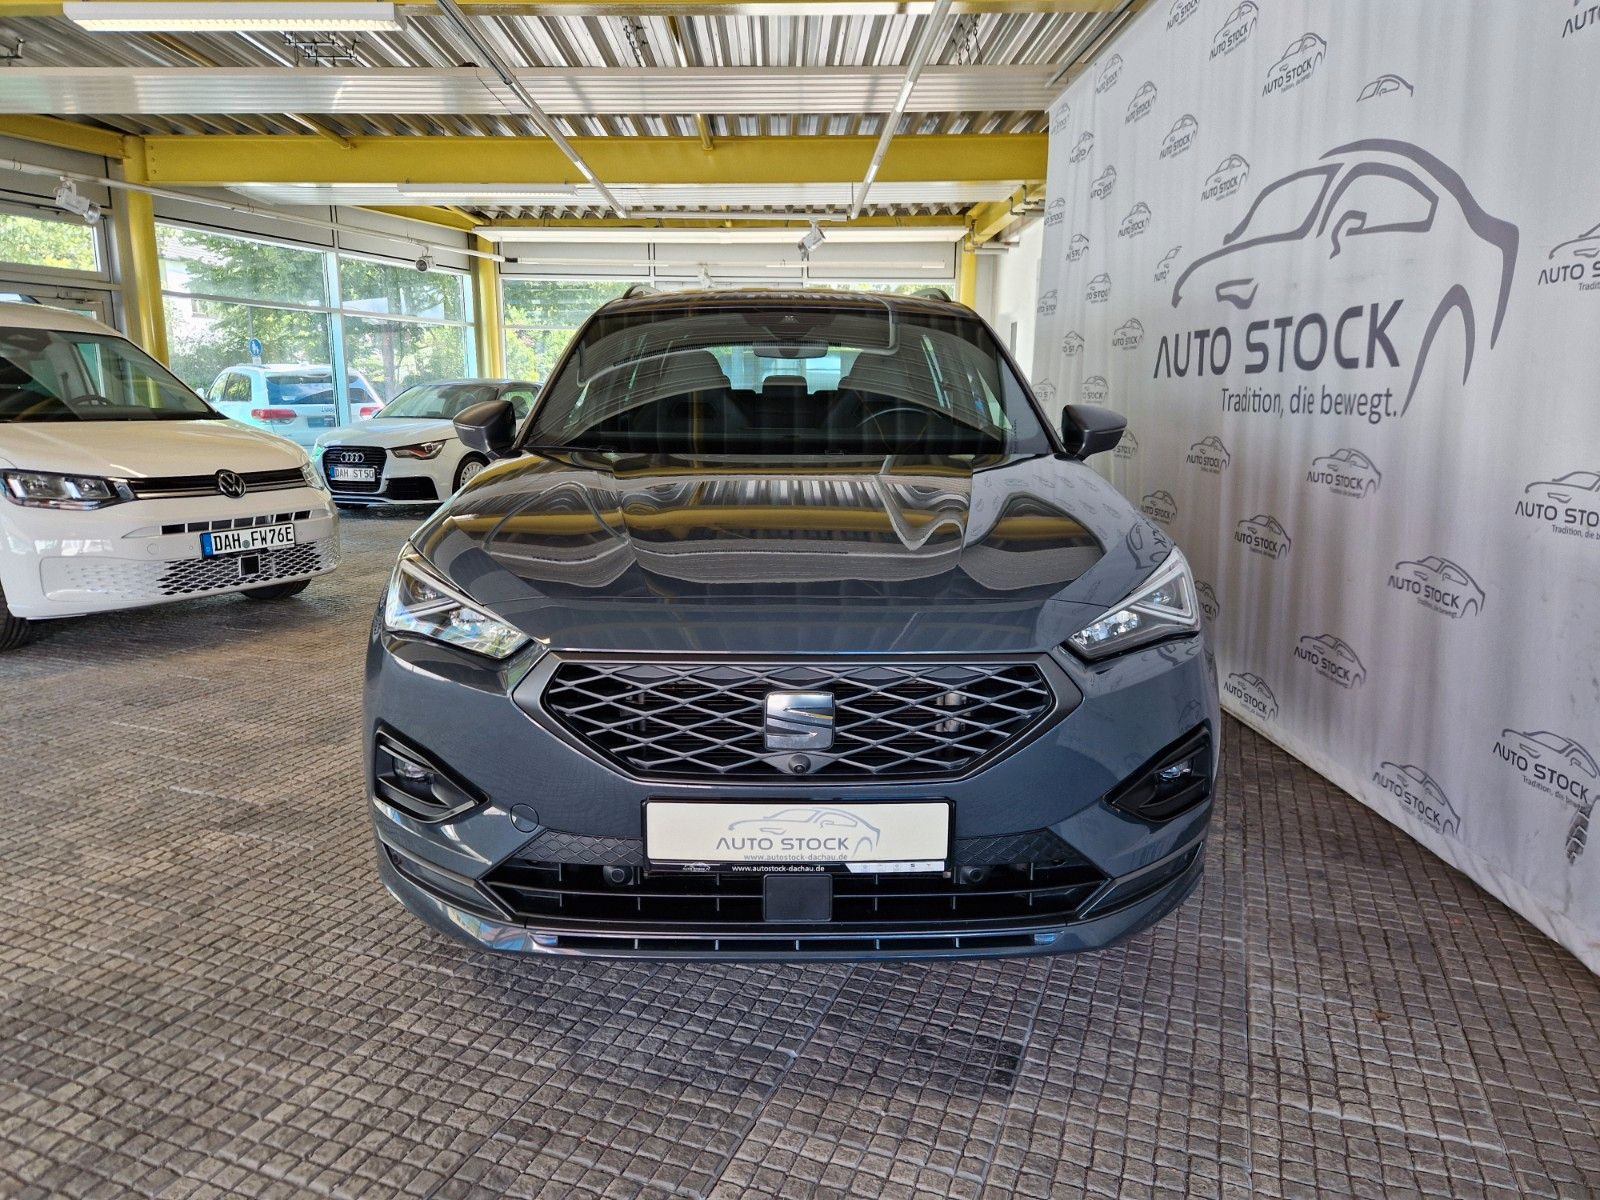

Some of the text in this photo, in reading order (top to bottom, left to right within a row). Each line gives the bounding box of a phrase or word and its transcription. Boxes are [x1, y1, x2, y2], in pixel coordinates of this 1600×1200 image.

[1562, 5, 1600, 38] AUT
[1262, 75, 1284, 97] AUTO
[1285, 56, 1312, 83] STOCK
[1538, 263, 1585, 285] AUTO
[1153, 299, 1404, 379] AUTO STOCK
[1221, 384, 1397, 425] Tradition, die bewegt.
[336, 469, 348, 477] DAH
[1306, 471, 1363, 490] AUTO STOCK
[1514, 500, 1558, 520] AUTO
[213, 532, 242, 552] DAH
[1233, 531, 1278, 552] AUTO STOCK
[1387, 575, 1421, 594] AUTO
[1424, 584, 1460, 609] STOCK
[1294, 646, 1319, 665] AUTO
[1321, 656, 1350, 682] STOCK
[1223, 681, 1243, 699] AUTO
[1243, 692, 1267, 713] STOCK
[1493, 741, 1589, 804] AUTO STOCK
[1372, 772, 1403, 797] AUTO
[1404, 791, 1441, 826] STOCK
[716, 837, 849, 851] AUTO STOCK
[743, 853, 848, 862] www.autostock-dachau.de
[731, 864, 825, 873] www.autostock-dachau.de
